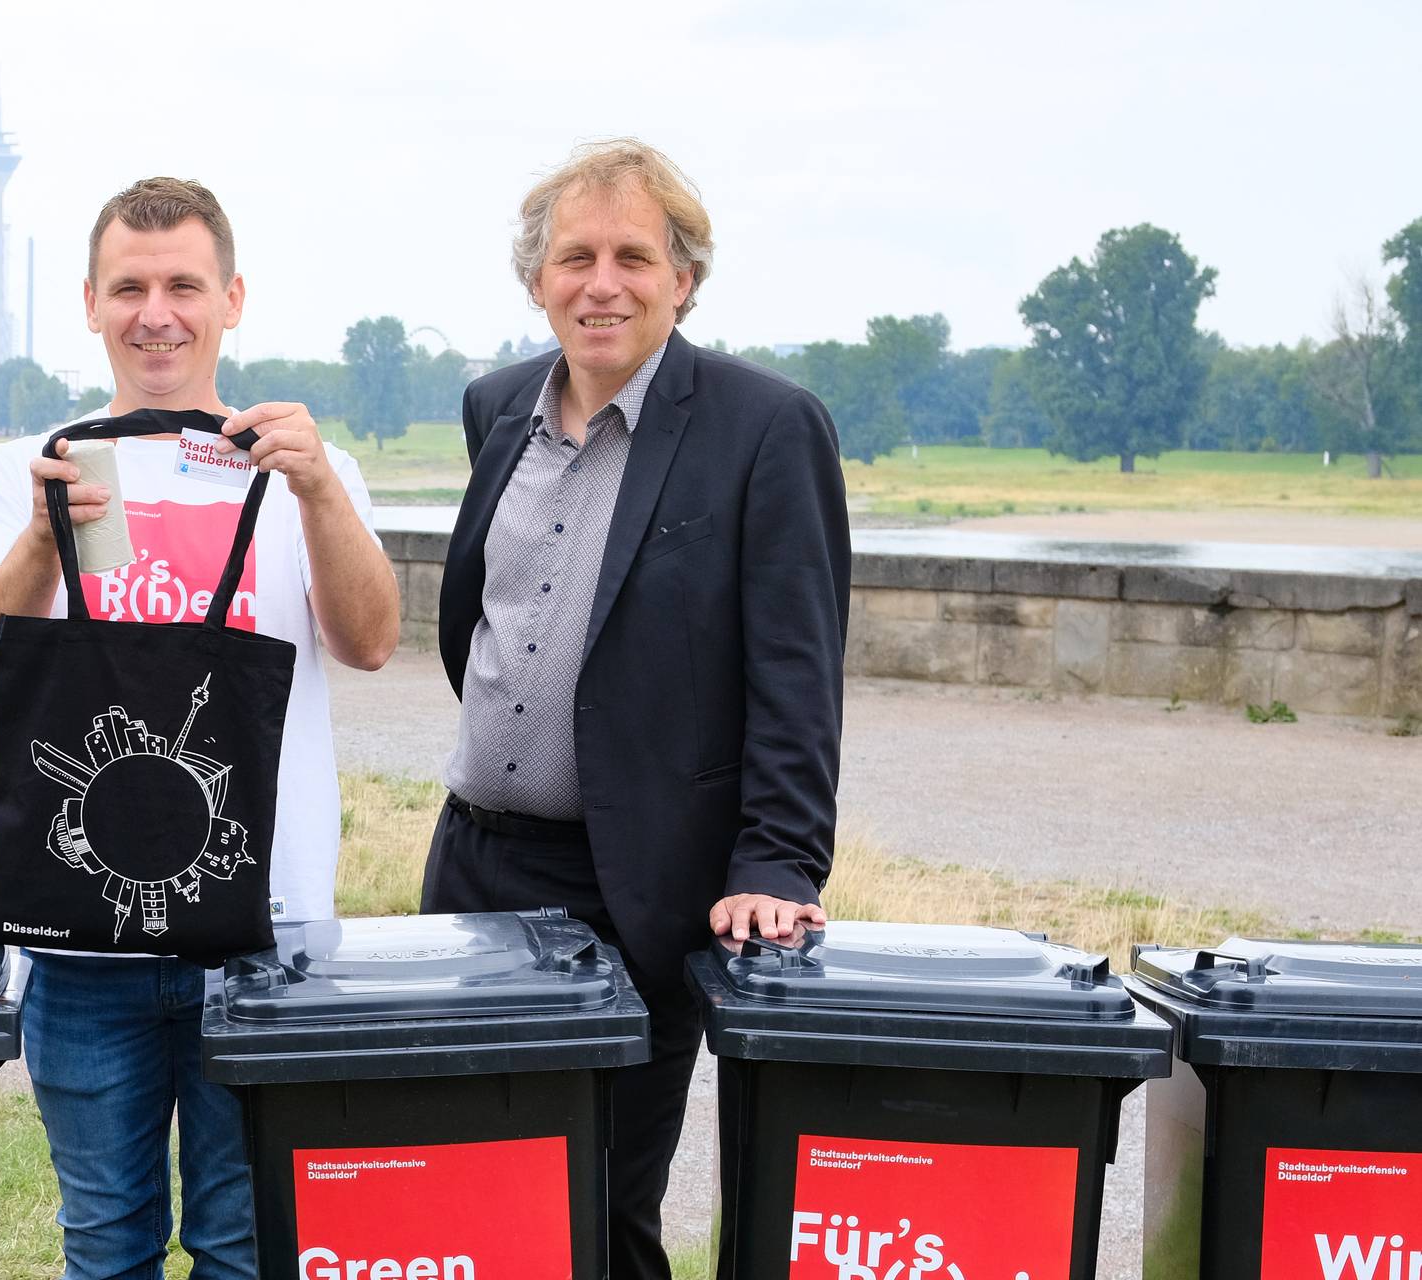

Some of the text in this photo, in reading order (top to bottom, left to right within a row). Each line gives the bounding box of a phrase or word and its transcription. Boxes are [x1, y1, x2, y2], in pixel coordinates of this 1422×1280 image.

[179, 438, 214, 455] Stadt
[100, 575, 256, 622] R(h)en
[2, 921, 71, 938] Düsseldorf
[368, 948, 467, 960] AWISTA
[810, 1148, 933, 1165] Stadtsauberkeitsoffensive
[810, 1158, 861, 1170] Düsseldorf
[307, 1159, 426, 1170] Stadtsauberkeitsoffensive
[1278, 1161, 1407, 1175] Stadtsauberkeitsoffensive
[307, 1170, 357, 1180] Düsseldorf
[1278, 1171, 1333, 1183] Düsseldorf
[790, 1210, 944, 1272] Für’s
[298, 1247, 475, 1280] Green
